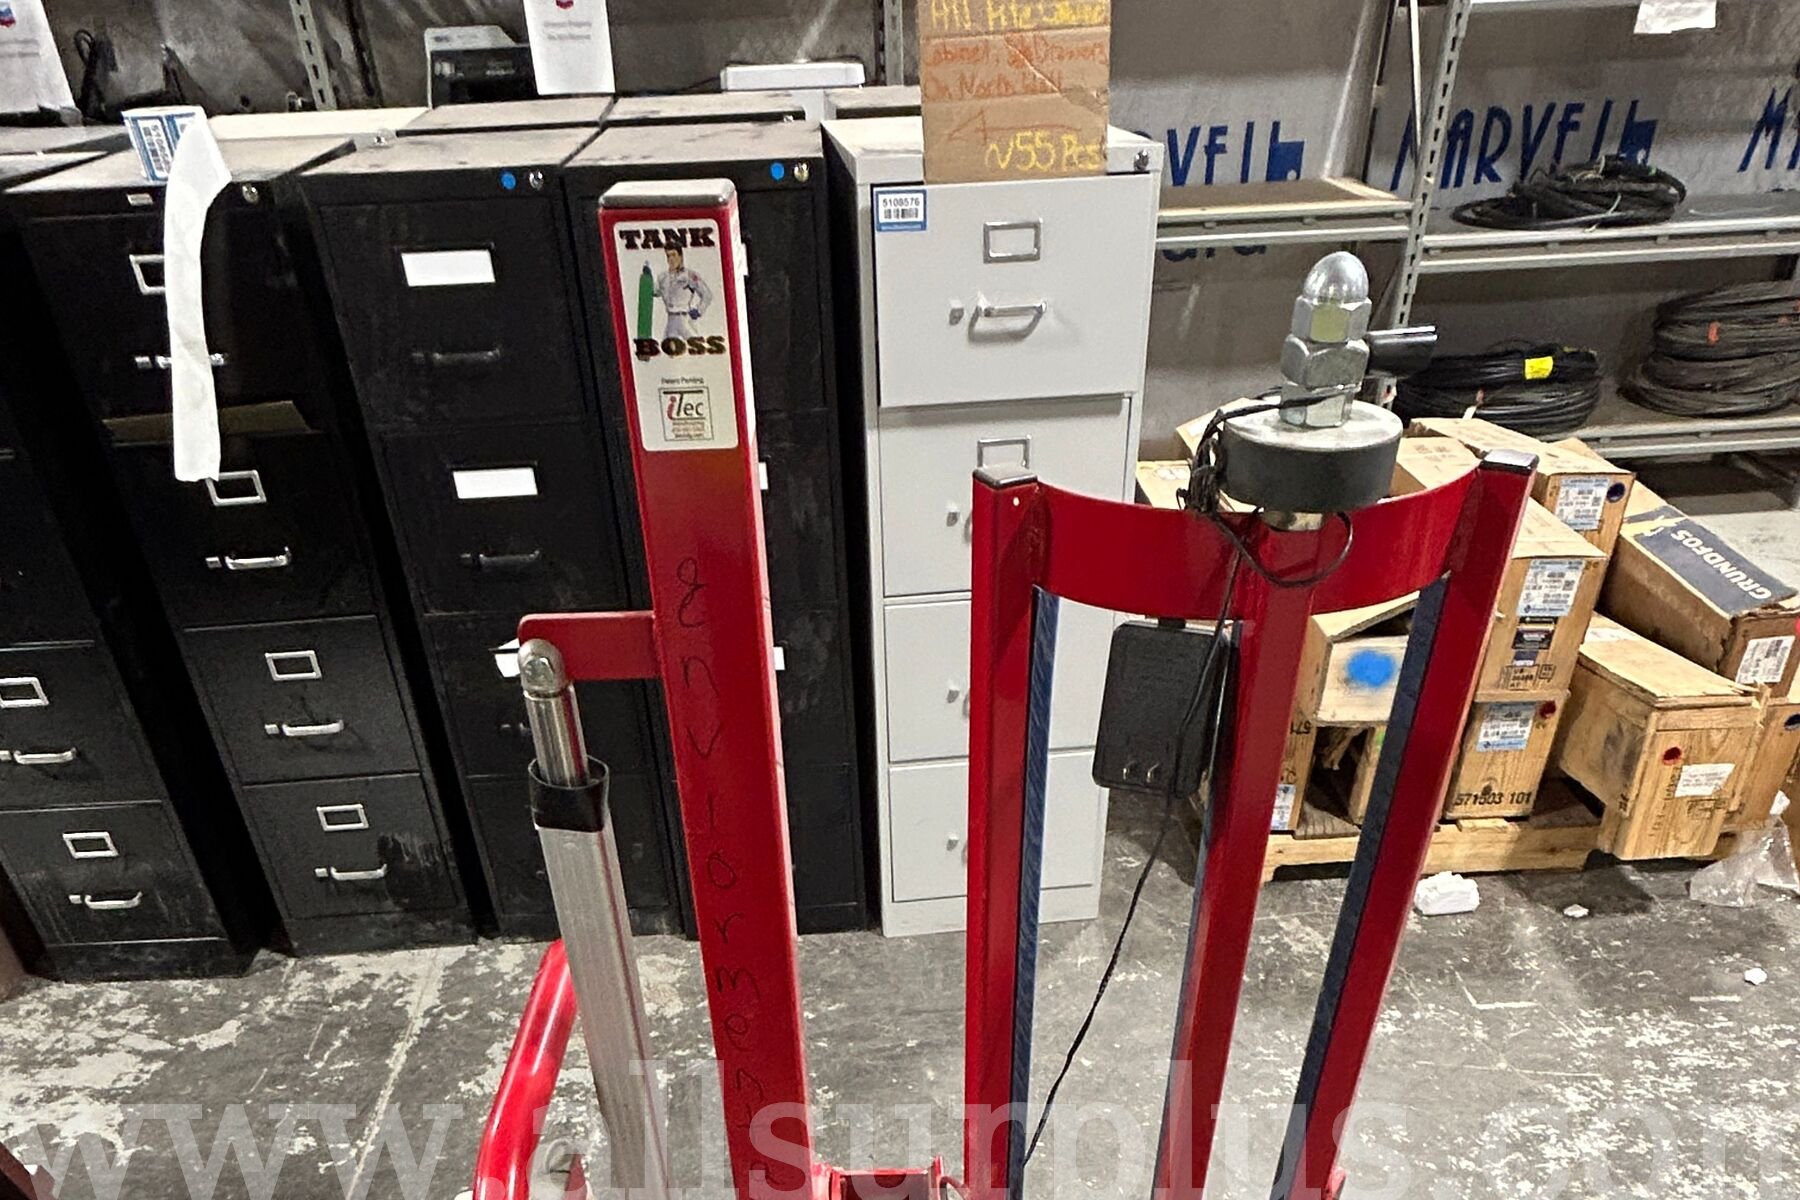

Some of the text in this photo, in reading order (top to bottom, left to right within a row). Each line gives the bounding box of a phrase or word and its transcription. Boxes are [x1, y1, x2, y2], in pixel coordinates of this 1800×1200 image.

[618, 227, 715, 250] TANK
[633, 336, 727, 357] BOSS
[1671, 529, 1773, 601] GRUNDFOS
[1509, 791, 1533, 805] 101
